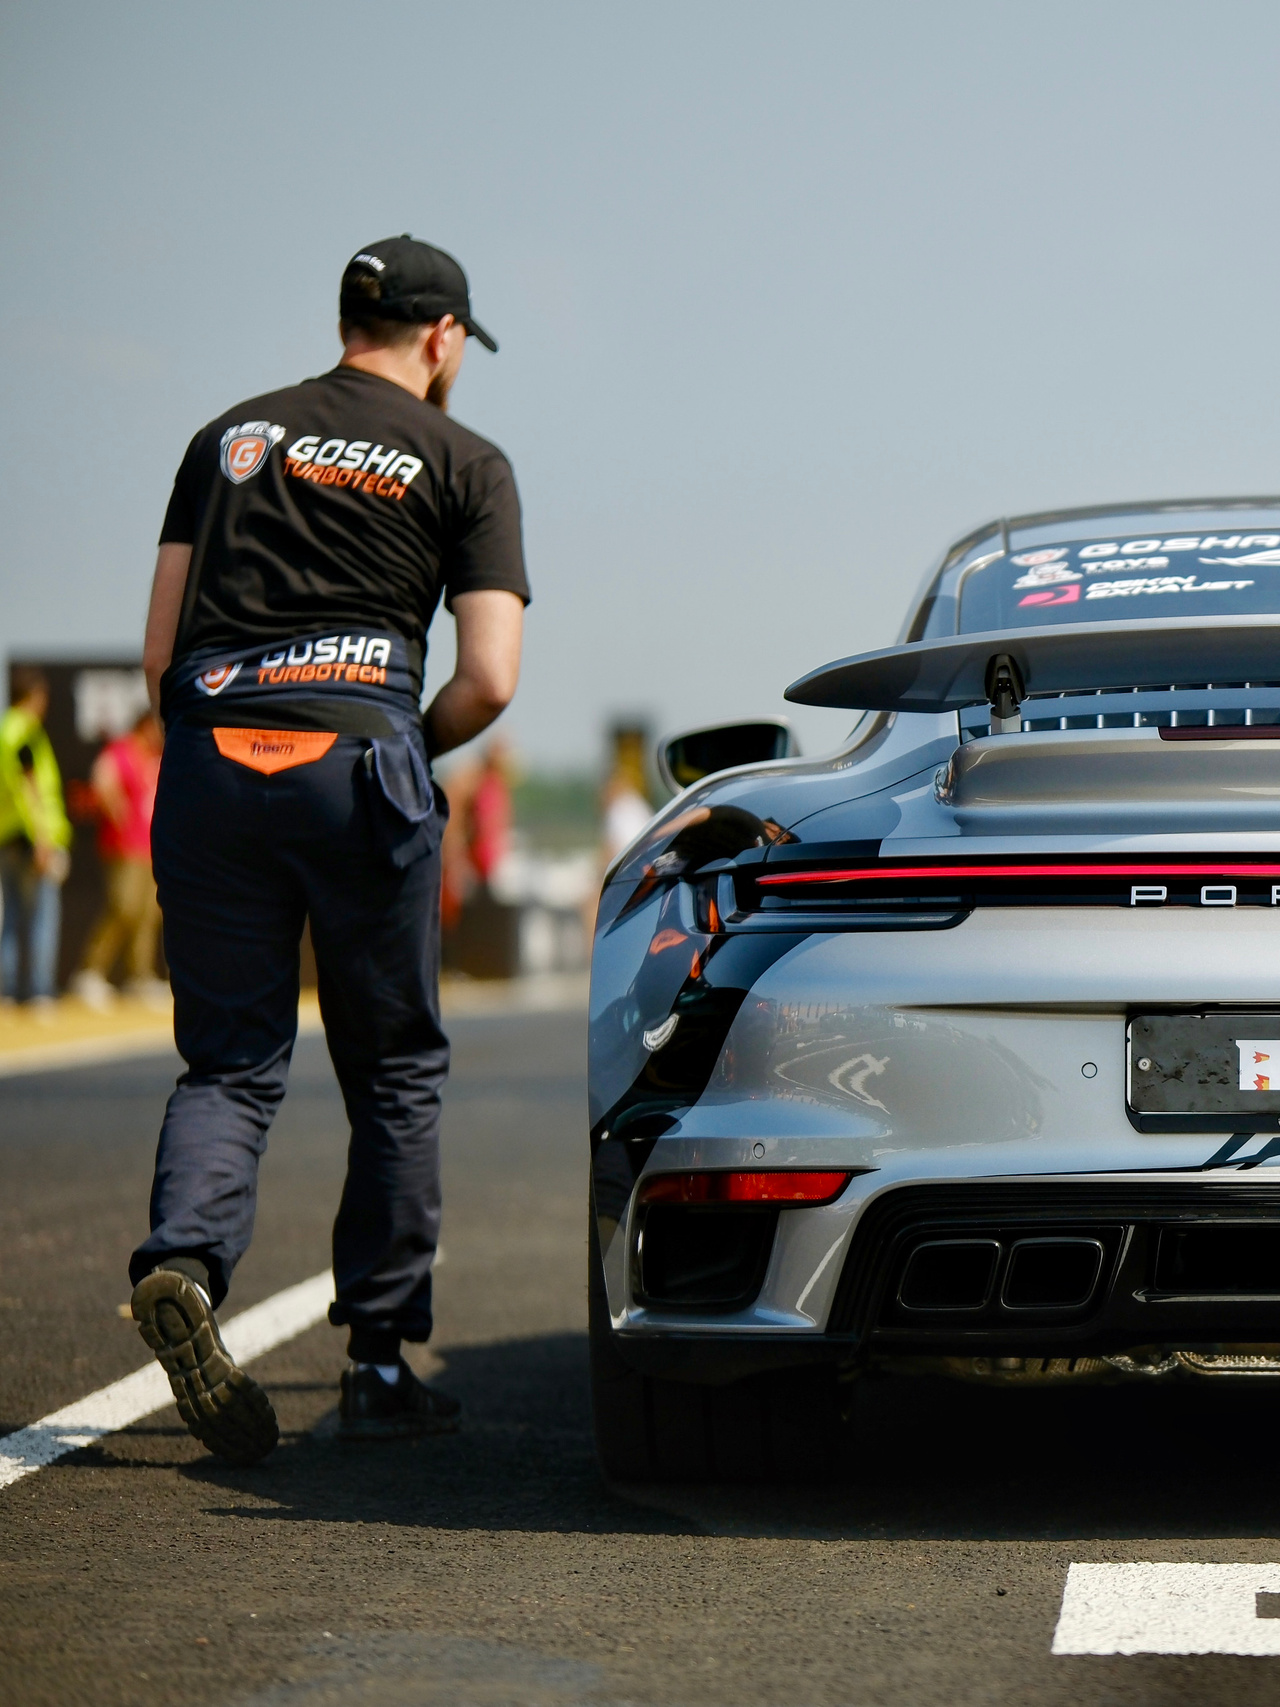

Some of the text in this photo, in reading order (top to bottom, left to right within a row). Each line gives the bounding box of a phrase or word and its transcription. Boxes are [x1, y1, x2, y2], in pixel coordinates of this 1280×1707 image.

[287, 435, 423, 485] GOSHA
[284, 457, 409, 500] TURBOTECH
[1081, 556, 1170, 573] TOYS
[1085, 580, 1254, 600] EXHAUST
[261, 635, 392, 669] GOSHA
[258, 662, 387, 685] TURBOTECH
[251, 741, 294, 756] freem
